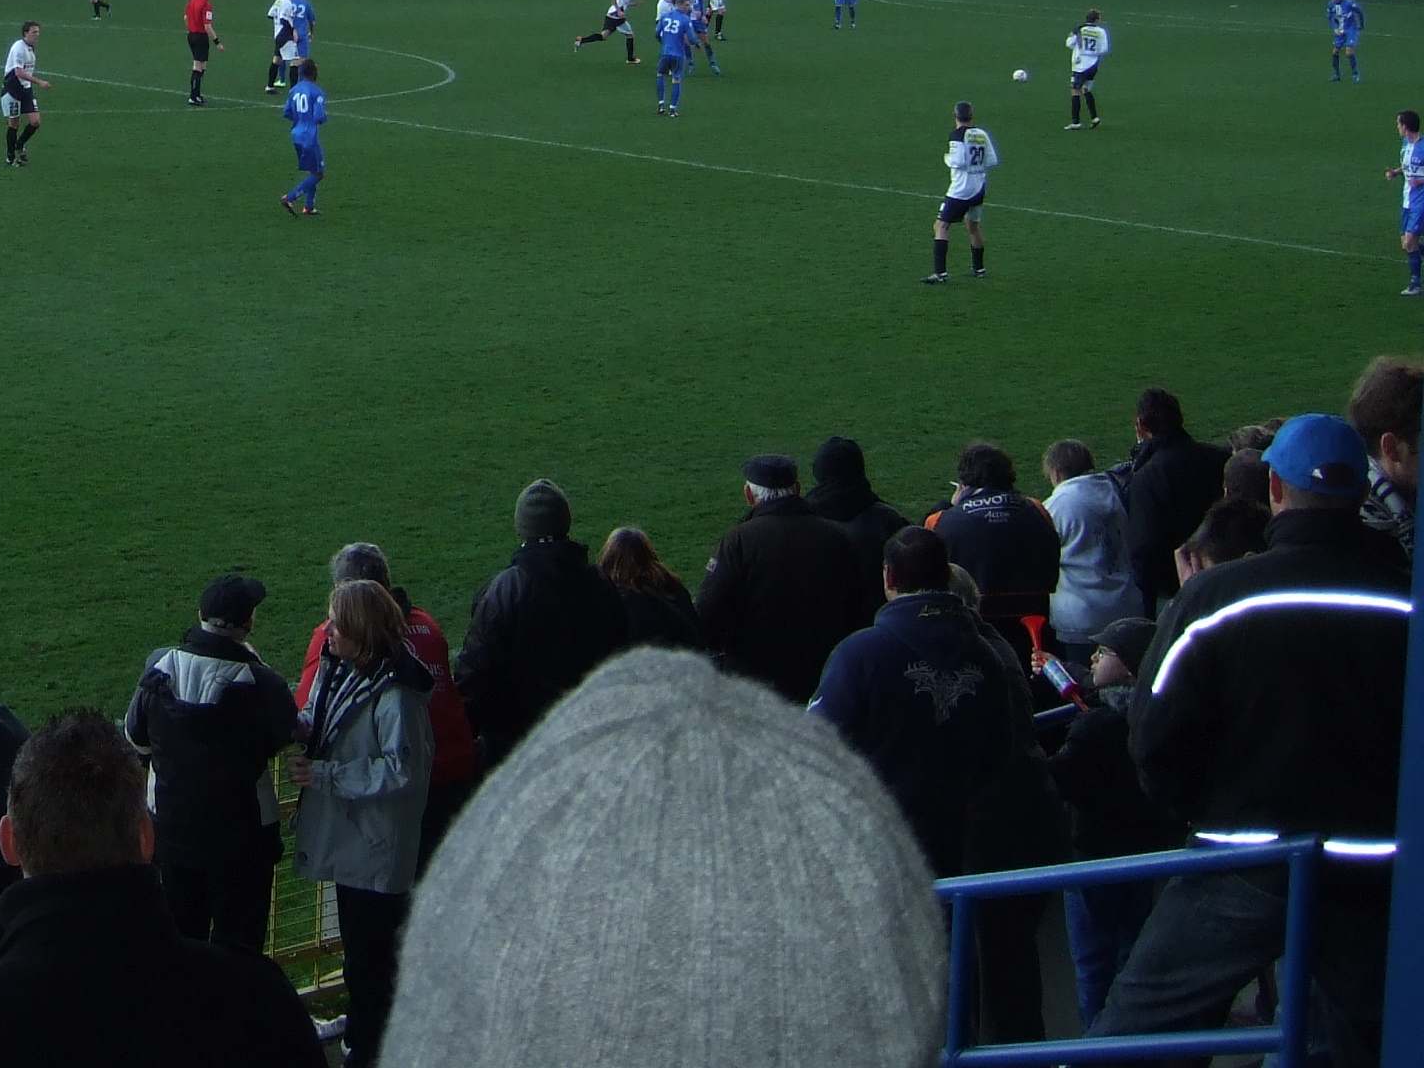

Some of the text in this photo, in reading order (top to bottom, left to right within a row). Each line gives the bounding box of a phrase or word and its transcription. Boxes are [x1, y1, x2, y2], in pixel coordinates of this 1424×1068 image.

[663, 17, 680, 34] 23
[1084, 37, 1097, 52] 12
[292, 92, 309, 114] 10
